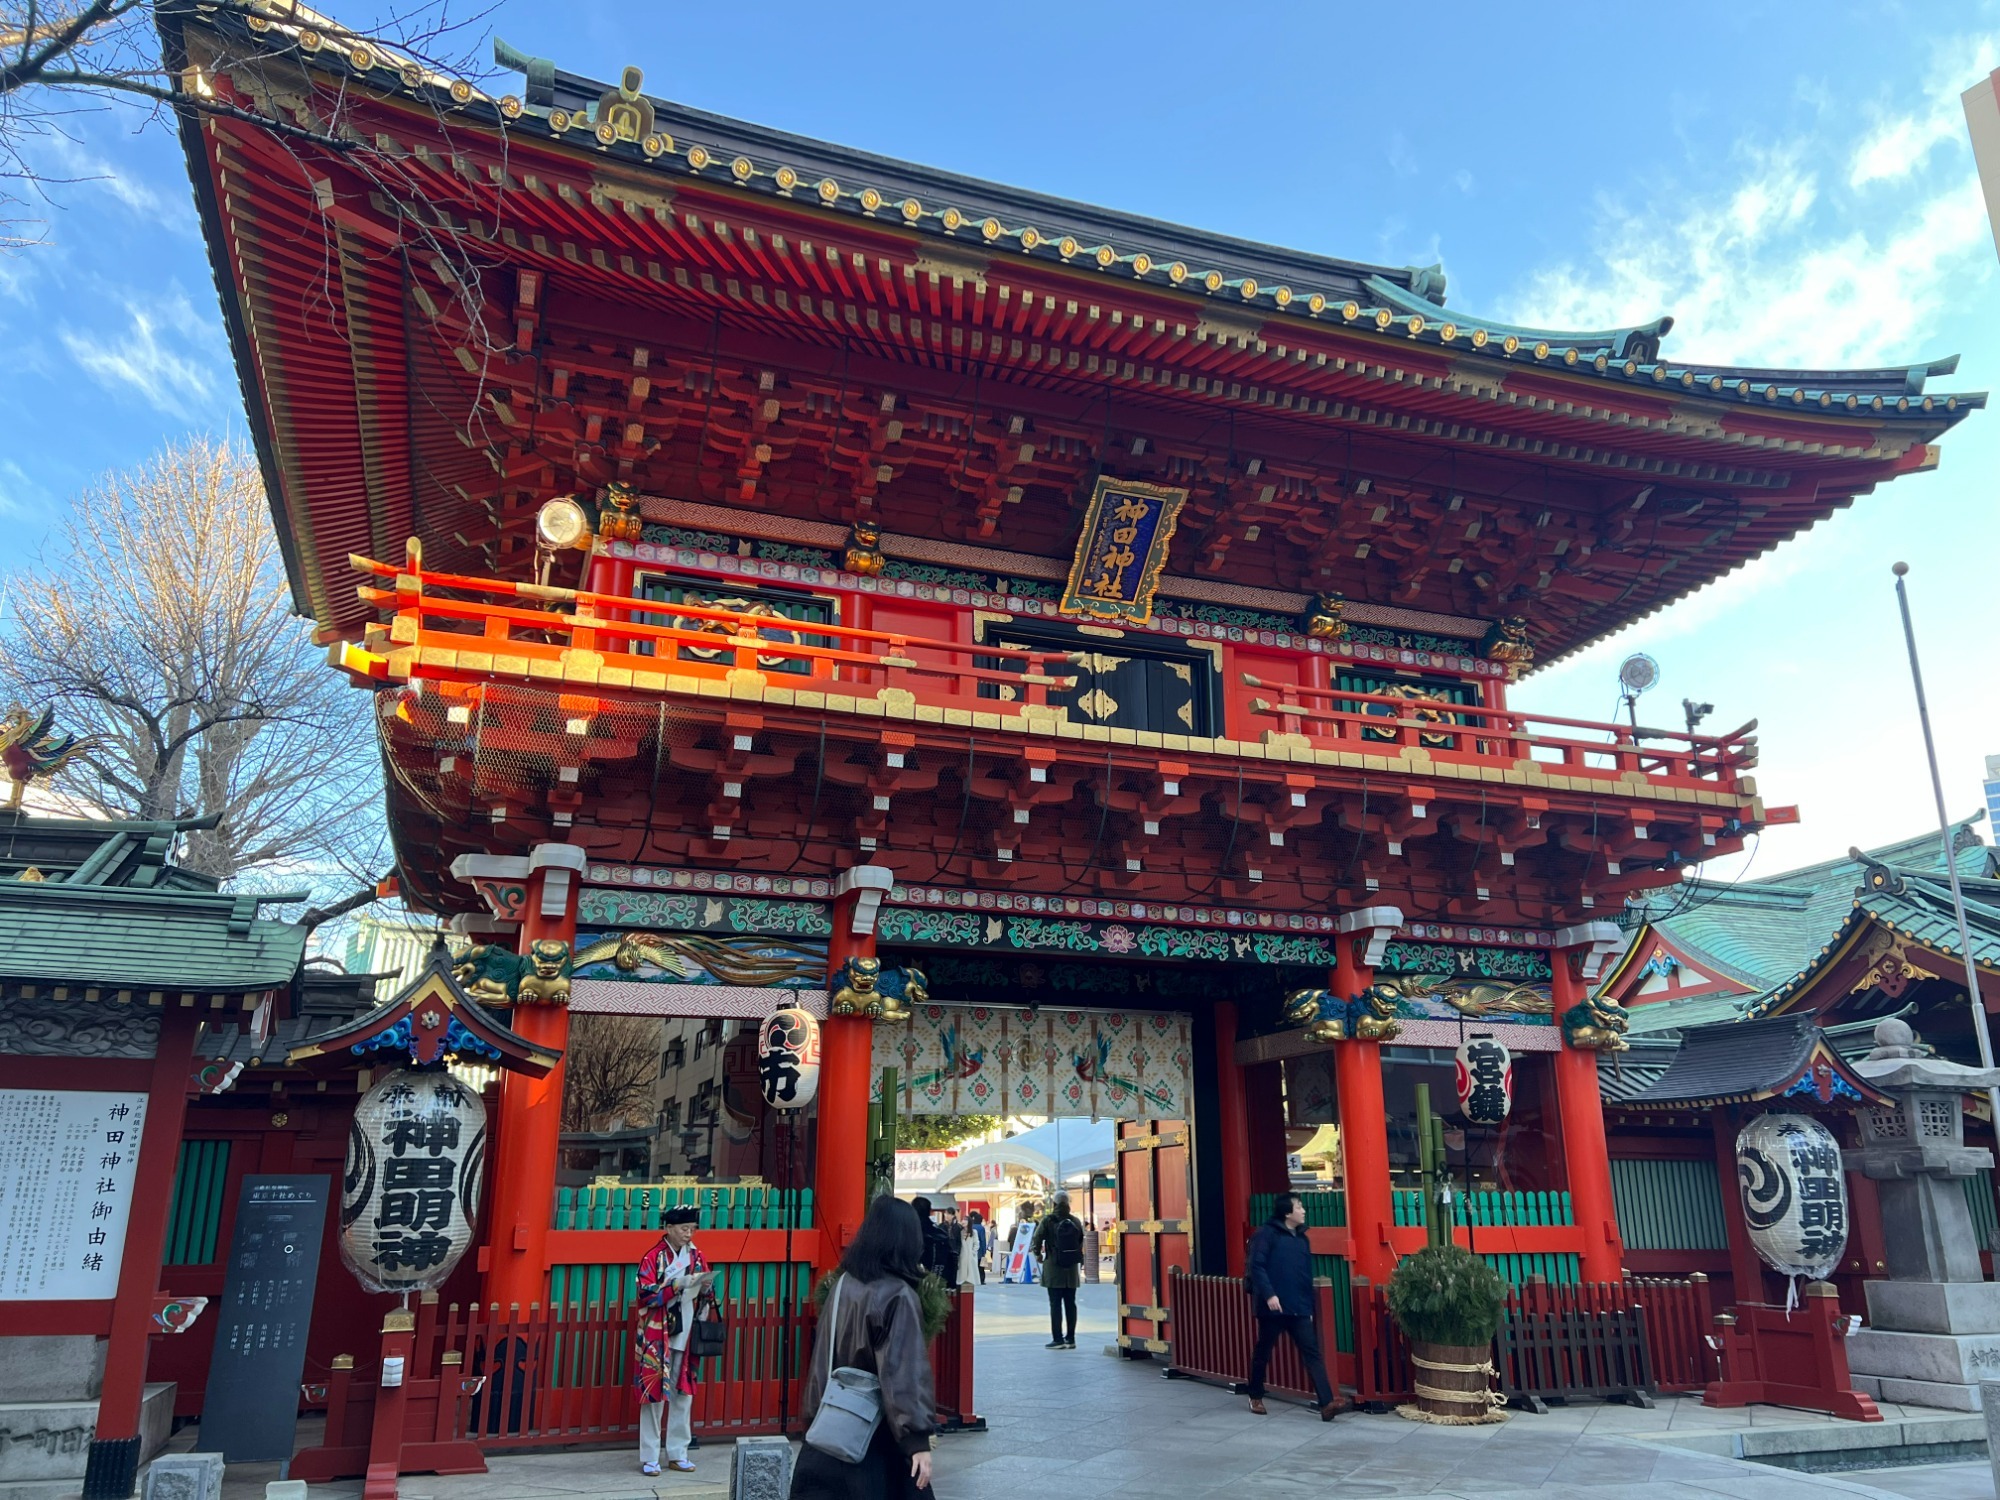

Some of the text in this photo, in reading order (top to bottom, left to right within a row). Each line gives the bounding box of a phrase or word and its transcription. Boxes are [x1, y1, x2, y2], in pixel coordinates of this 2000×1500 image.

[1093, 498, 1150, 598] 神田神社
[81, 1102, 130, 1272] 神田神社御由緒
[370, 1109, 462, 1272] 神田明神
[1790, 1141, 1845, 1260] 神田明神
